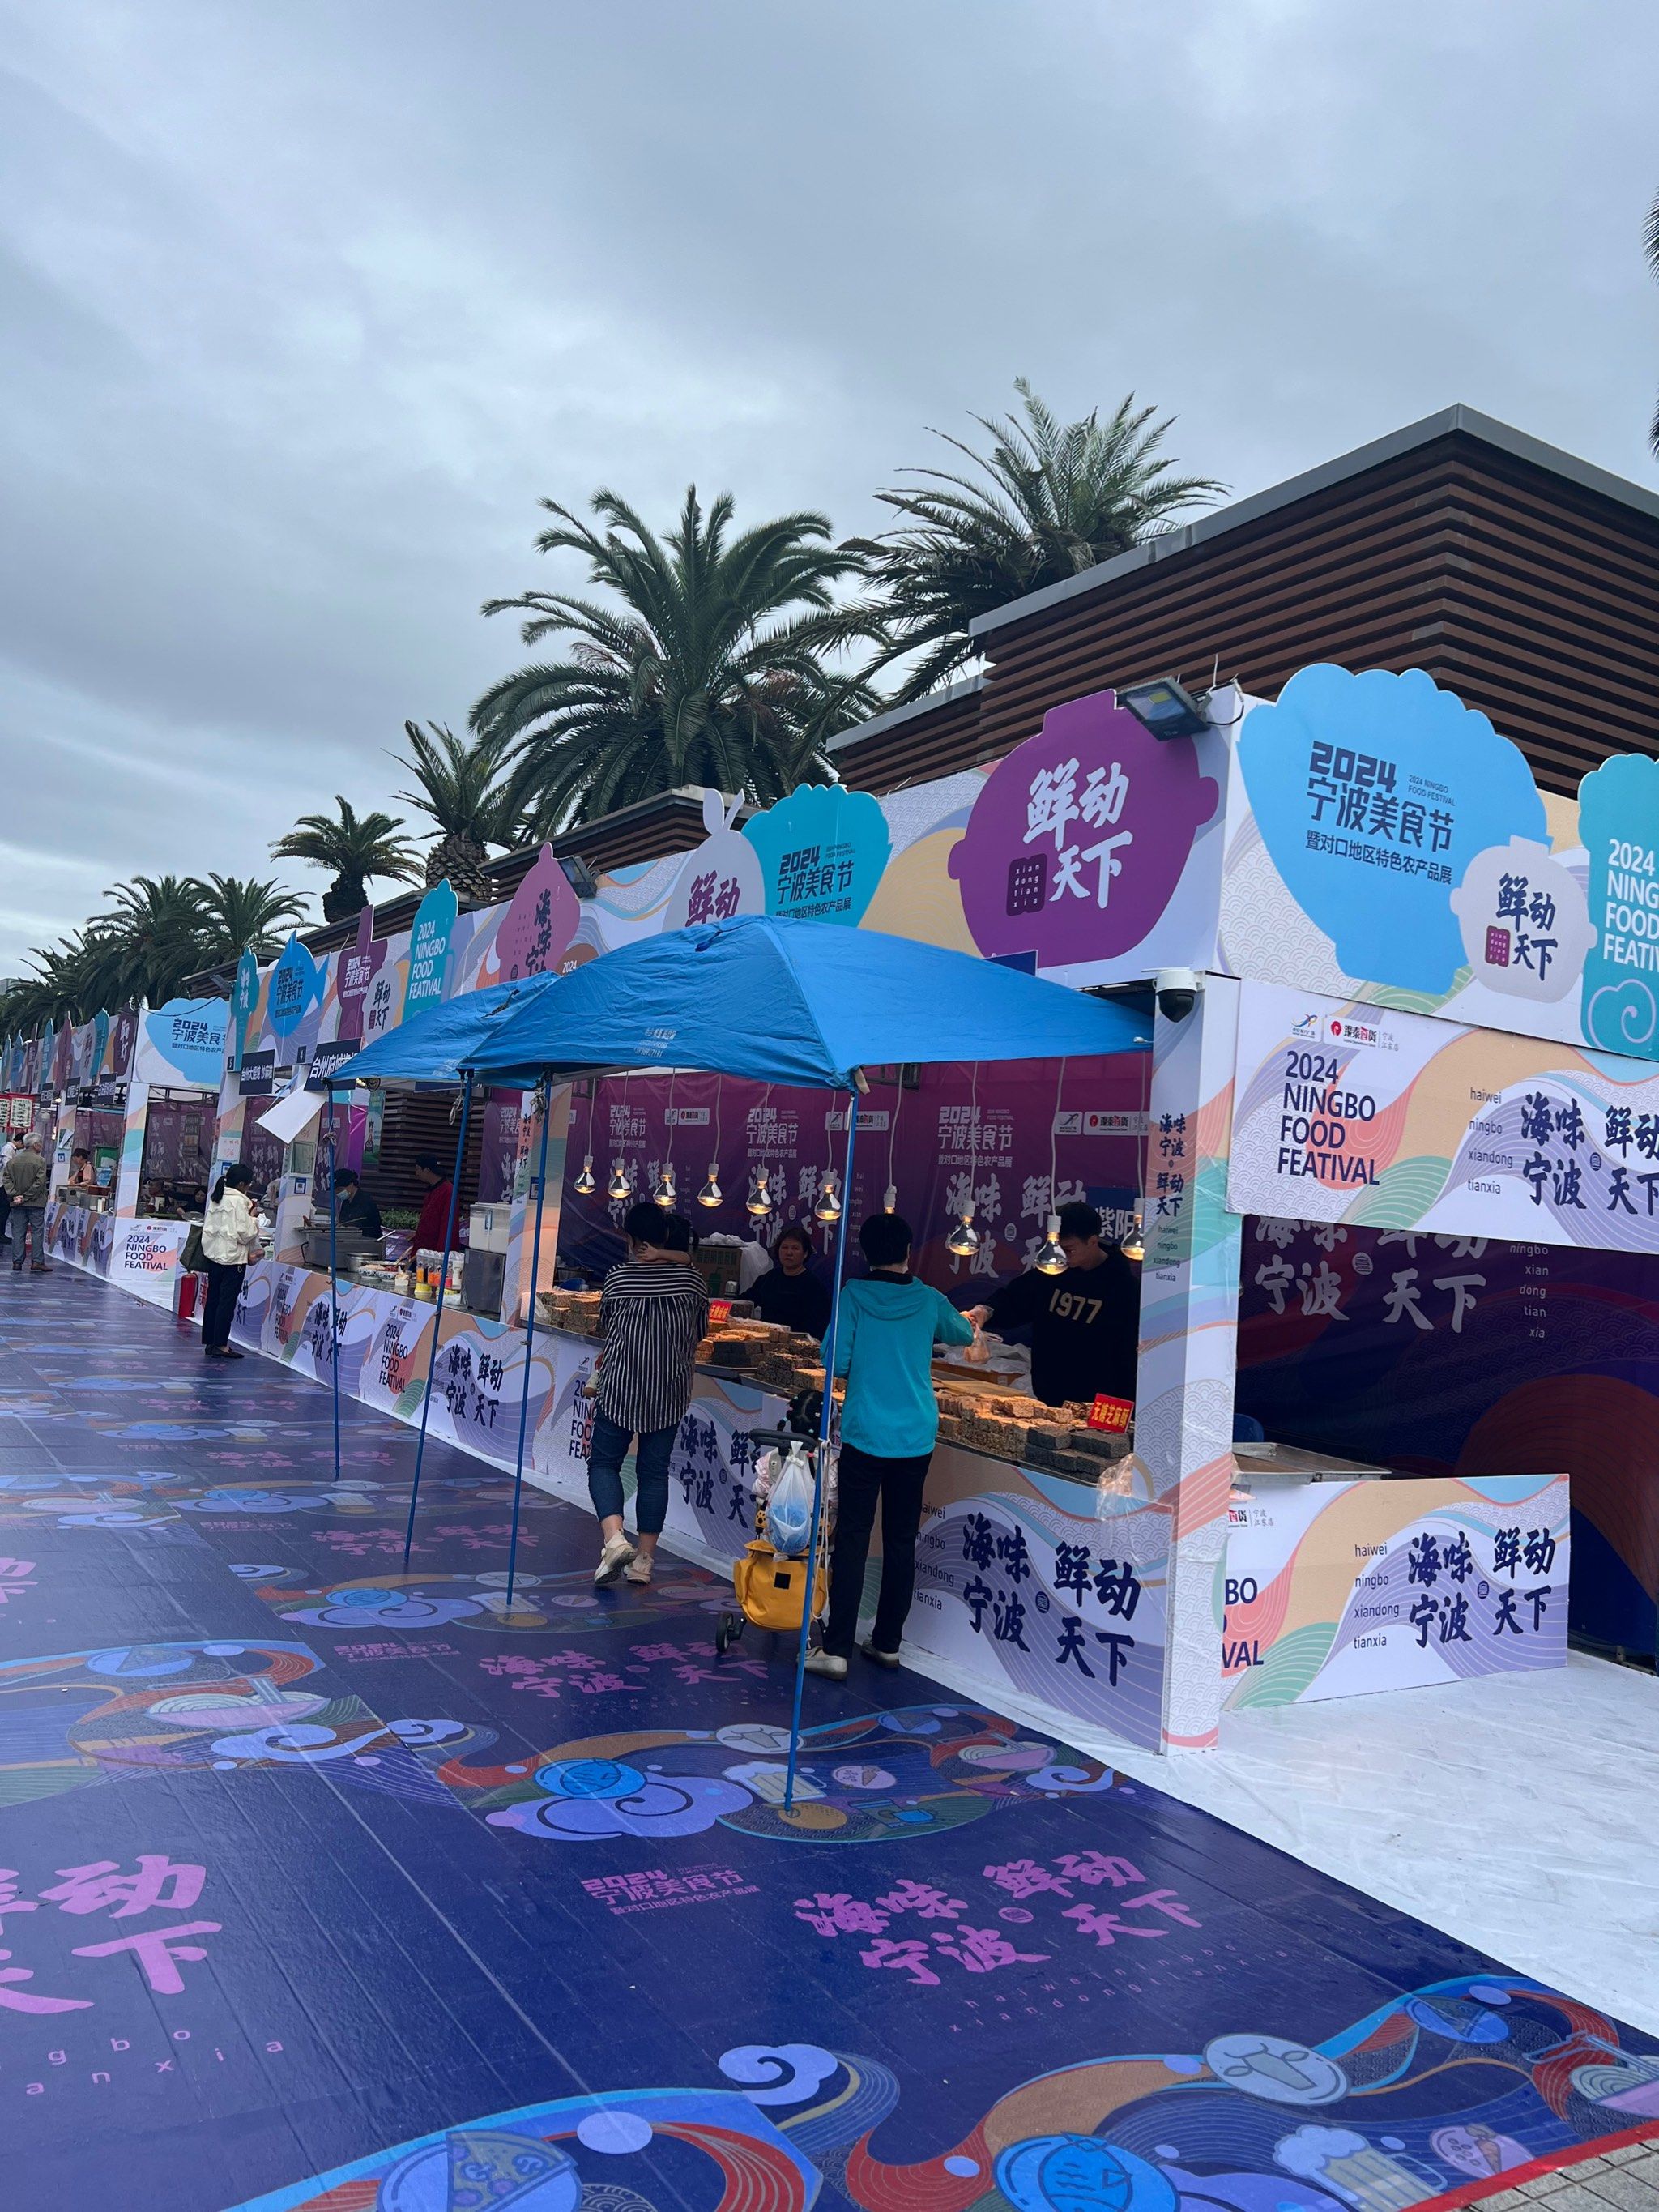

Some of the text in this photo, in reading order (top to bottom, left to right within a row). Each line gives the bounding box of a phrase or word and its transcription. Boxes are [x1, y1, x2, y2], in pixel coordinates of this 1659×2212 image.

[1309, 741, 1397, 793] 2024
[1408, 785, 1456, 806] FOOD FESTIVAL
[1424, 779, 1448, 793] NINGBO
[1022, 758, 1129, 851] 鲜动
[1307, 776, 1454, 852] 宁波美食节
[779, 845, 821, 876] 2024
[1306, 830, 1452, 885] 暨对口地区特色农产品展
[1608, 838, 1655, 877] 2024
[1048, 830, 1133, 909] 天下
[777, 860, 854, 905] 宁波美食节
[685, 870, 740, 928] 鲜动
[1495, 873, 1555, 932] 鲜动
[417, 920, 435, 941] 2024
[1606, 901, 1659, 940] FOOD
[415, 936, 446, 960] NINGBO
[1512, 933, 1558, 981] 天下
[412, 959, 434, 980] FOOD
[562, 960, 578, 973] 2024
[408, 977, 441, 1000] FEATIVAL
[173, 1018, 207, 1031] 2024
[375, 1008, 390, 1030] 天下
[300, 1050, 304, 1060] 4
[1286, 1050, 1338, 1085] 2024
[1282, 1083, 1375, 1121] NINGBO
[1469, 1087, 1502, 1104] haiwei
[748, 1108, 777, 1123] 2024
[939, 1106, 981, 1123] 2024
[1159, 1113, 1186, 1134] 海味
[1520, 1091, 1585, 1151] 海味
[746, 1123, 799, 1145] 宁波美食节
[938, 1124, 1013, 1151] 宁波美食节
[1281, 1115, 1346, 1149] FOOD
[1469, 1119, 1503, 1136] ningbo
[1159, 1136, 1185, 1157] 宁波
[1277, 1147, 1380, 1186] FEATIVAL
[1468, 1149, 1513, 1169] xiandong
[1156, 1172, 1184, 1194] 鲜动
[1468, 1179, 1501, 1194] tianxia
[1523, 1151, 1659, 1216] 宁波 天下
[1156, 1196, 1183, 1217] 天下
[127, 1235, 150, 1243] 2024
[1158, 1224, 1178, 1235] haiwei
[126, 1244, 166, 1253] NINGBO
[126, 1252, 153, 1261] FOOD
[1157, 1241, 1178, 1251] ningbo
[1509, 1244, 1549, 1257] ningbo
[125, 1261, 168, 1270] FEATIVAL
[1153, 1258, 1180, 1268] xiandong
[1525, 1265, 1549, 1276] xian
[1254, 1254, 1486, 1334] 宁波 天下
[1519, 1284, 1546, 1299] dong
[1048, 1288, 1102, 1324] 1977
[1524, 1305, 1546, 1318] tian
[386, 1323, 400, 1340] 2024
[1529, 1327, 1546, 1339] xia
[383, 1341, 408, 1360] NINGBO
[381, 1354, 399, 1372] FOOD
[448, 1344, 471, 1381] 海味
[477, 1353, 503, 1392] 鲜动
[378, 1369, 406, 1394] FEATIVAL
[446, 1380, 499, 1428] 宁波 天下
[680, 1414, 718, 1465] 海味
[680, 1461, 715, 1515] 宁波
[915, 1530, 945, 1550] ningbo
[1354, 1543, 1388, 1557] haiwei
[962, 1512, 1141, 1621] 海味 鲜动
[1409, 1527, 1556, 1588] 海味 鲜动
[915, 1560, 954, 1586] xiandong
[1354, 1573, 1389, 1590] ningbo
[914, 1589, 943, 1611] tianxia
[1354, 1602, 1399, 1619] xiandong
[1410, 1585, 1552, 1649] 宁波 天下
[963, 1576, 1135, 1686] 宁波 天下
[1354, 1634, 1387, 1650] tianxia
[479, 1650, 606, 1676] 海味
[512, 1659, 769, 1697] 宁波 天下
[581, 1869, 667, 1892] 2024
[591, 1870, 744, 1905] 宁波美食节
[793, 1851, 1146, 1937] 海味 鲜动
[859, 1888, 1202, 1986] 宁波 天下
